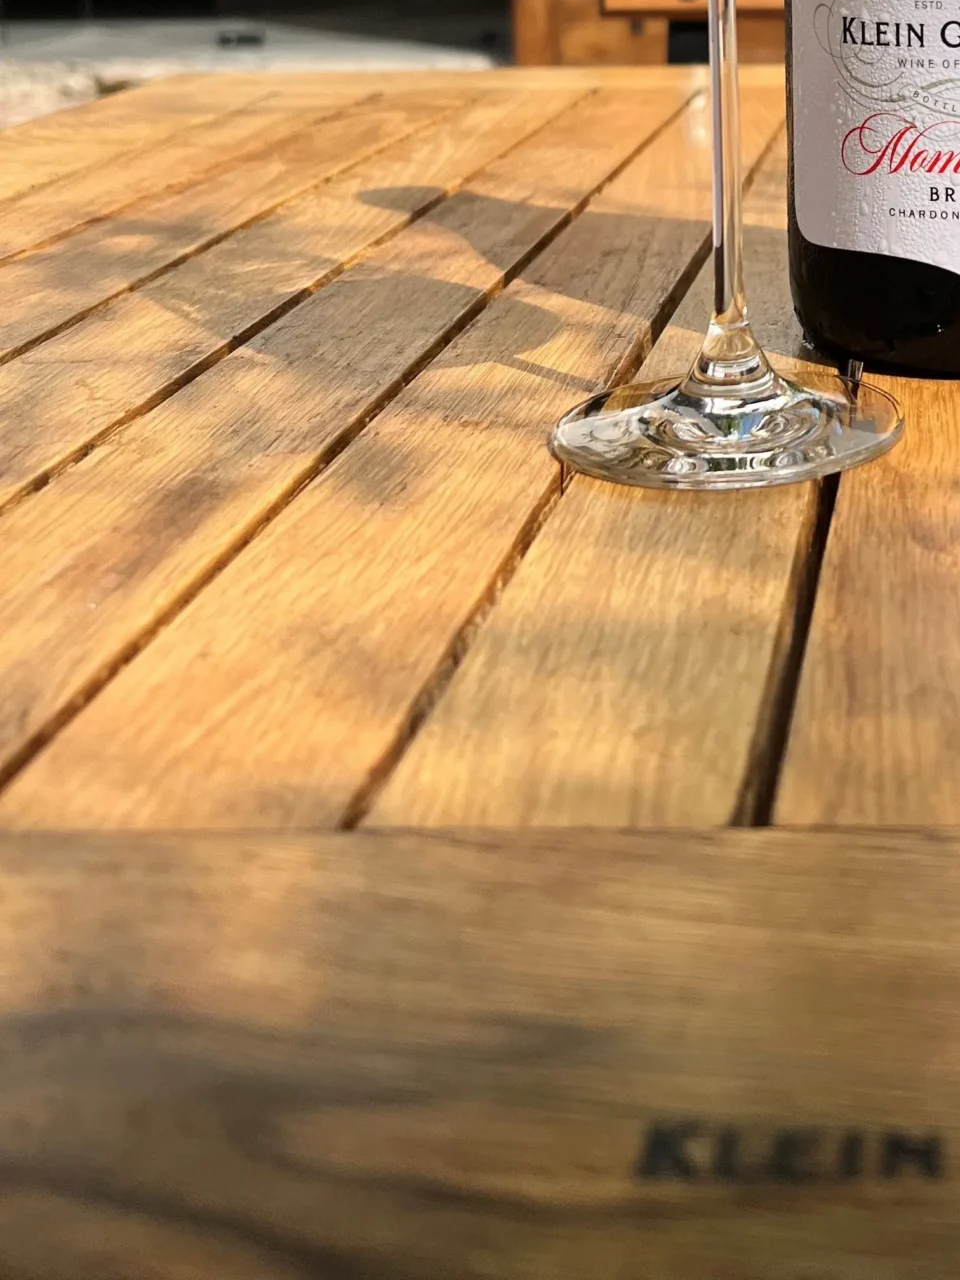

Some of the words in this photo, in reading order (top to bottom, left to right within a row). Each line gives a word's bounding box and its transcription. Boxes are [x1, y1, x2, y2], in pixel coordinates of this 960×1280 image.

[841, 16, 925, 48] KLEIN
[897, 57, 935, 69] WINE
[942, 59, 960, 70] OF
[635, 1122, 945, 1181] KLEIN
